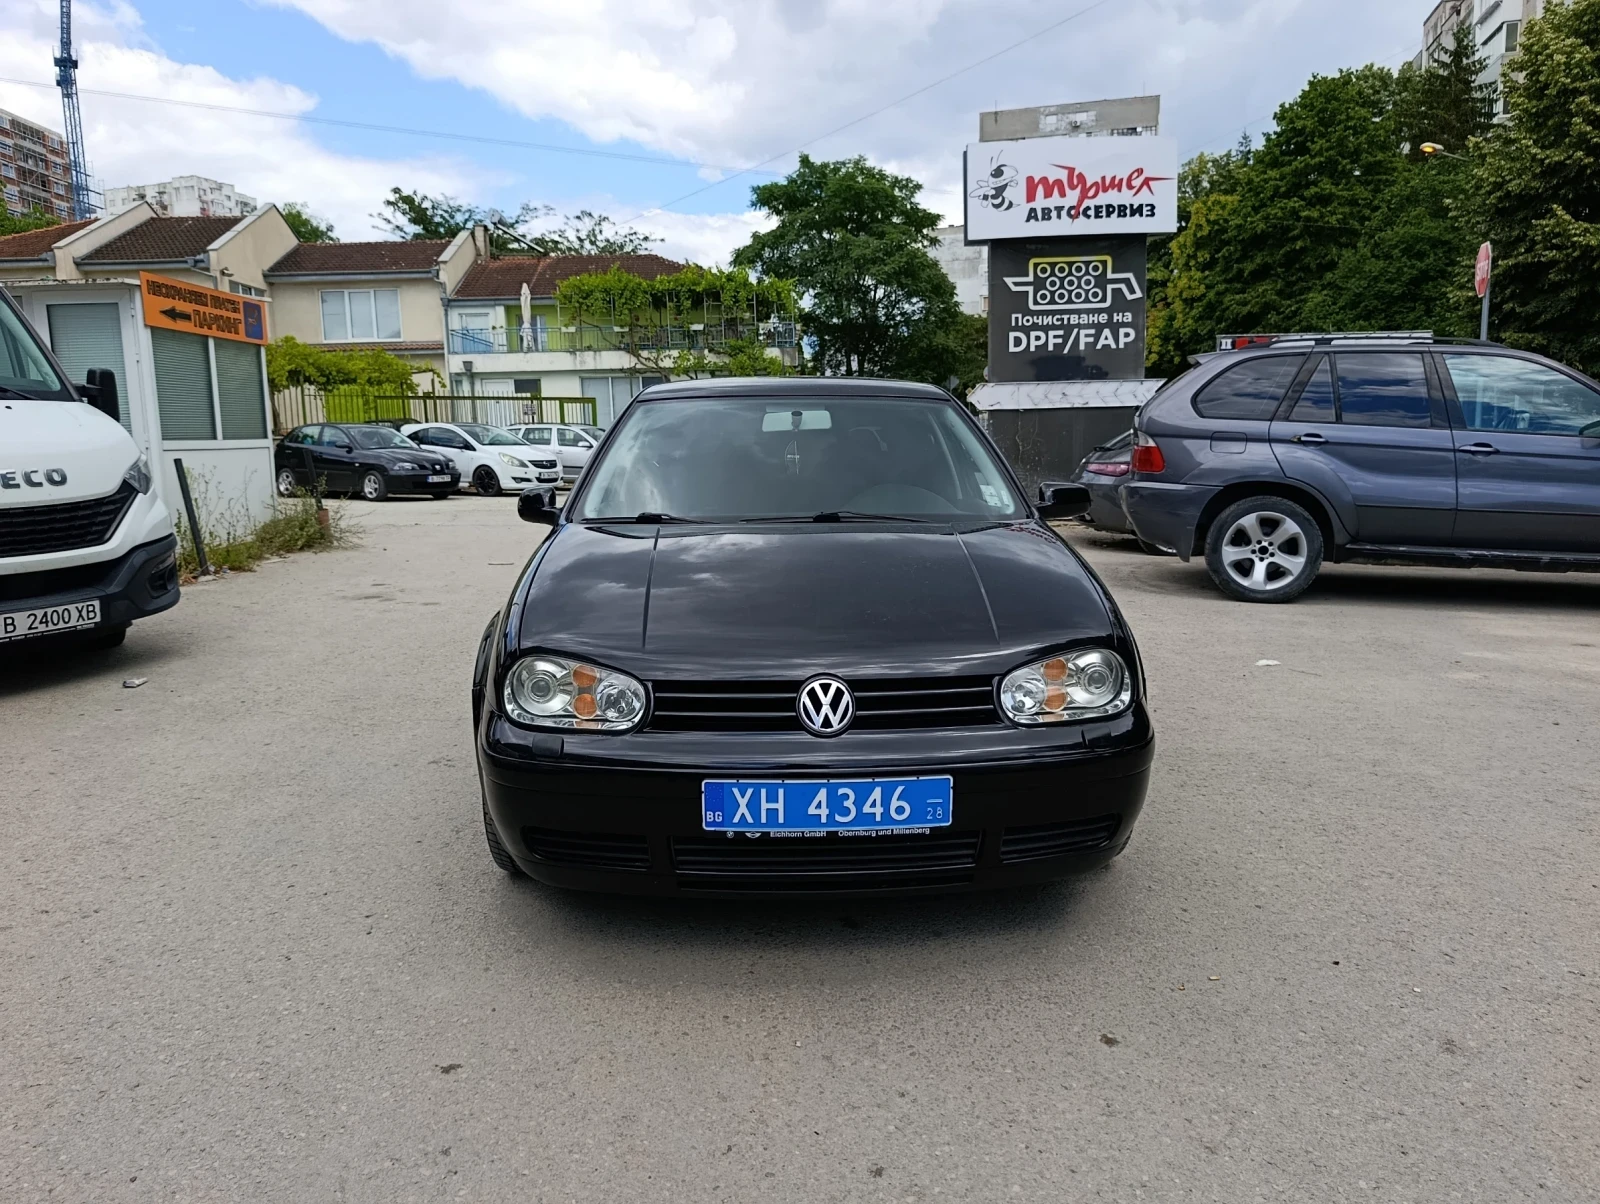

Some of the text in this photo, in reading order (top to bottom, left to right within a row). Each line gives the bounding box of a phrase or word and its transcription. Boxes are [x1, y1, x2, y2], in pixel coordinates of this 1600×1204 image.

[1025, 203, 1156, 223] АВТОСЕРВИЗ
[192, 309, 242, 335] ПАРКИНГ
[1011, 312, 1133, 327] Почистване на
[1009, 327, 1136, 354] DPF/FAP
[27, 607, 71, 631] 2400
[731, 785, 944, 824] XH 4346 28
[706, 811, 723, 822] BG
[770, 830, 803, 838] Eichhorn
[804, 830, 827, 838] GmbH
[838, 829, 876, 838] Obernburg
[878, 828, 891, 836] und
